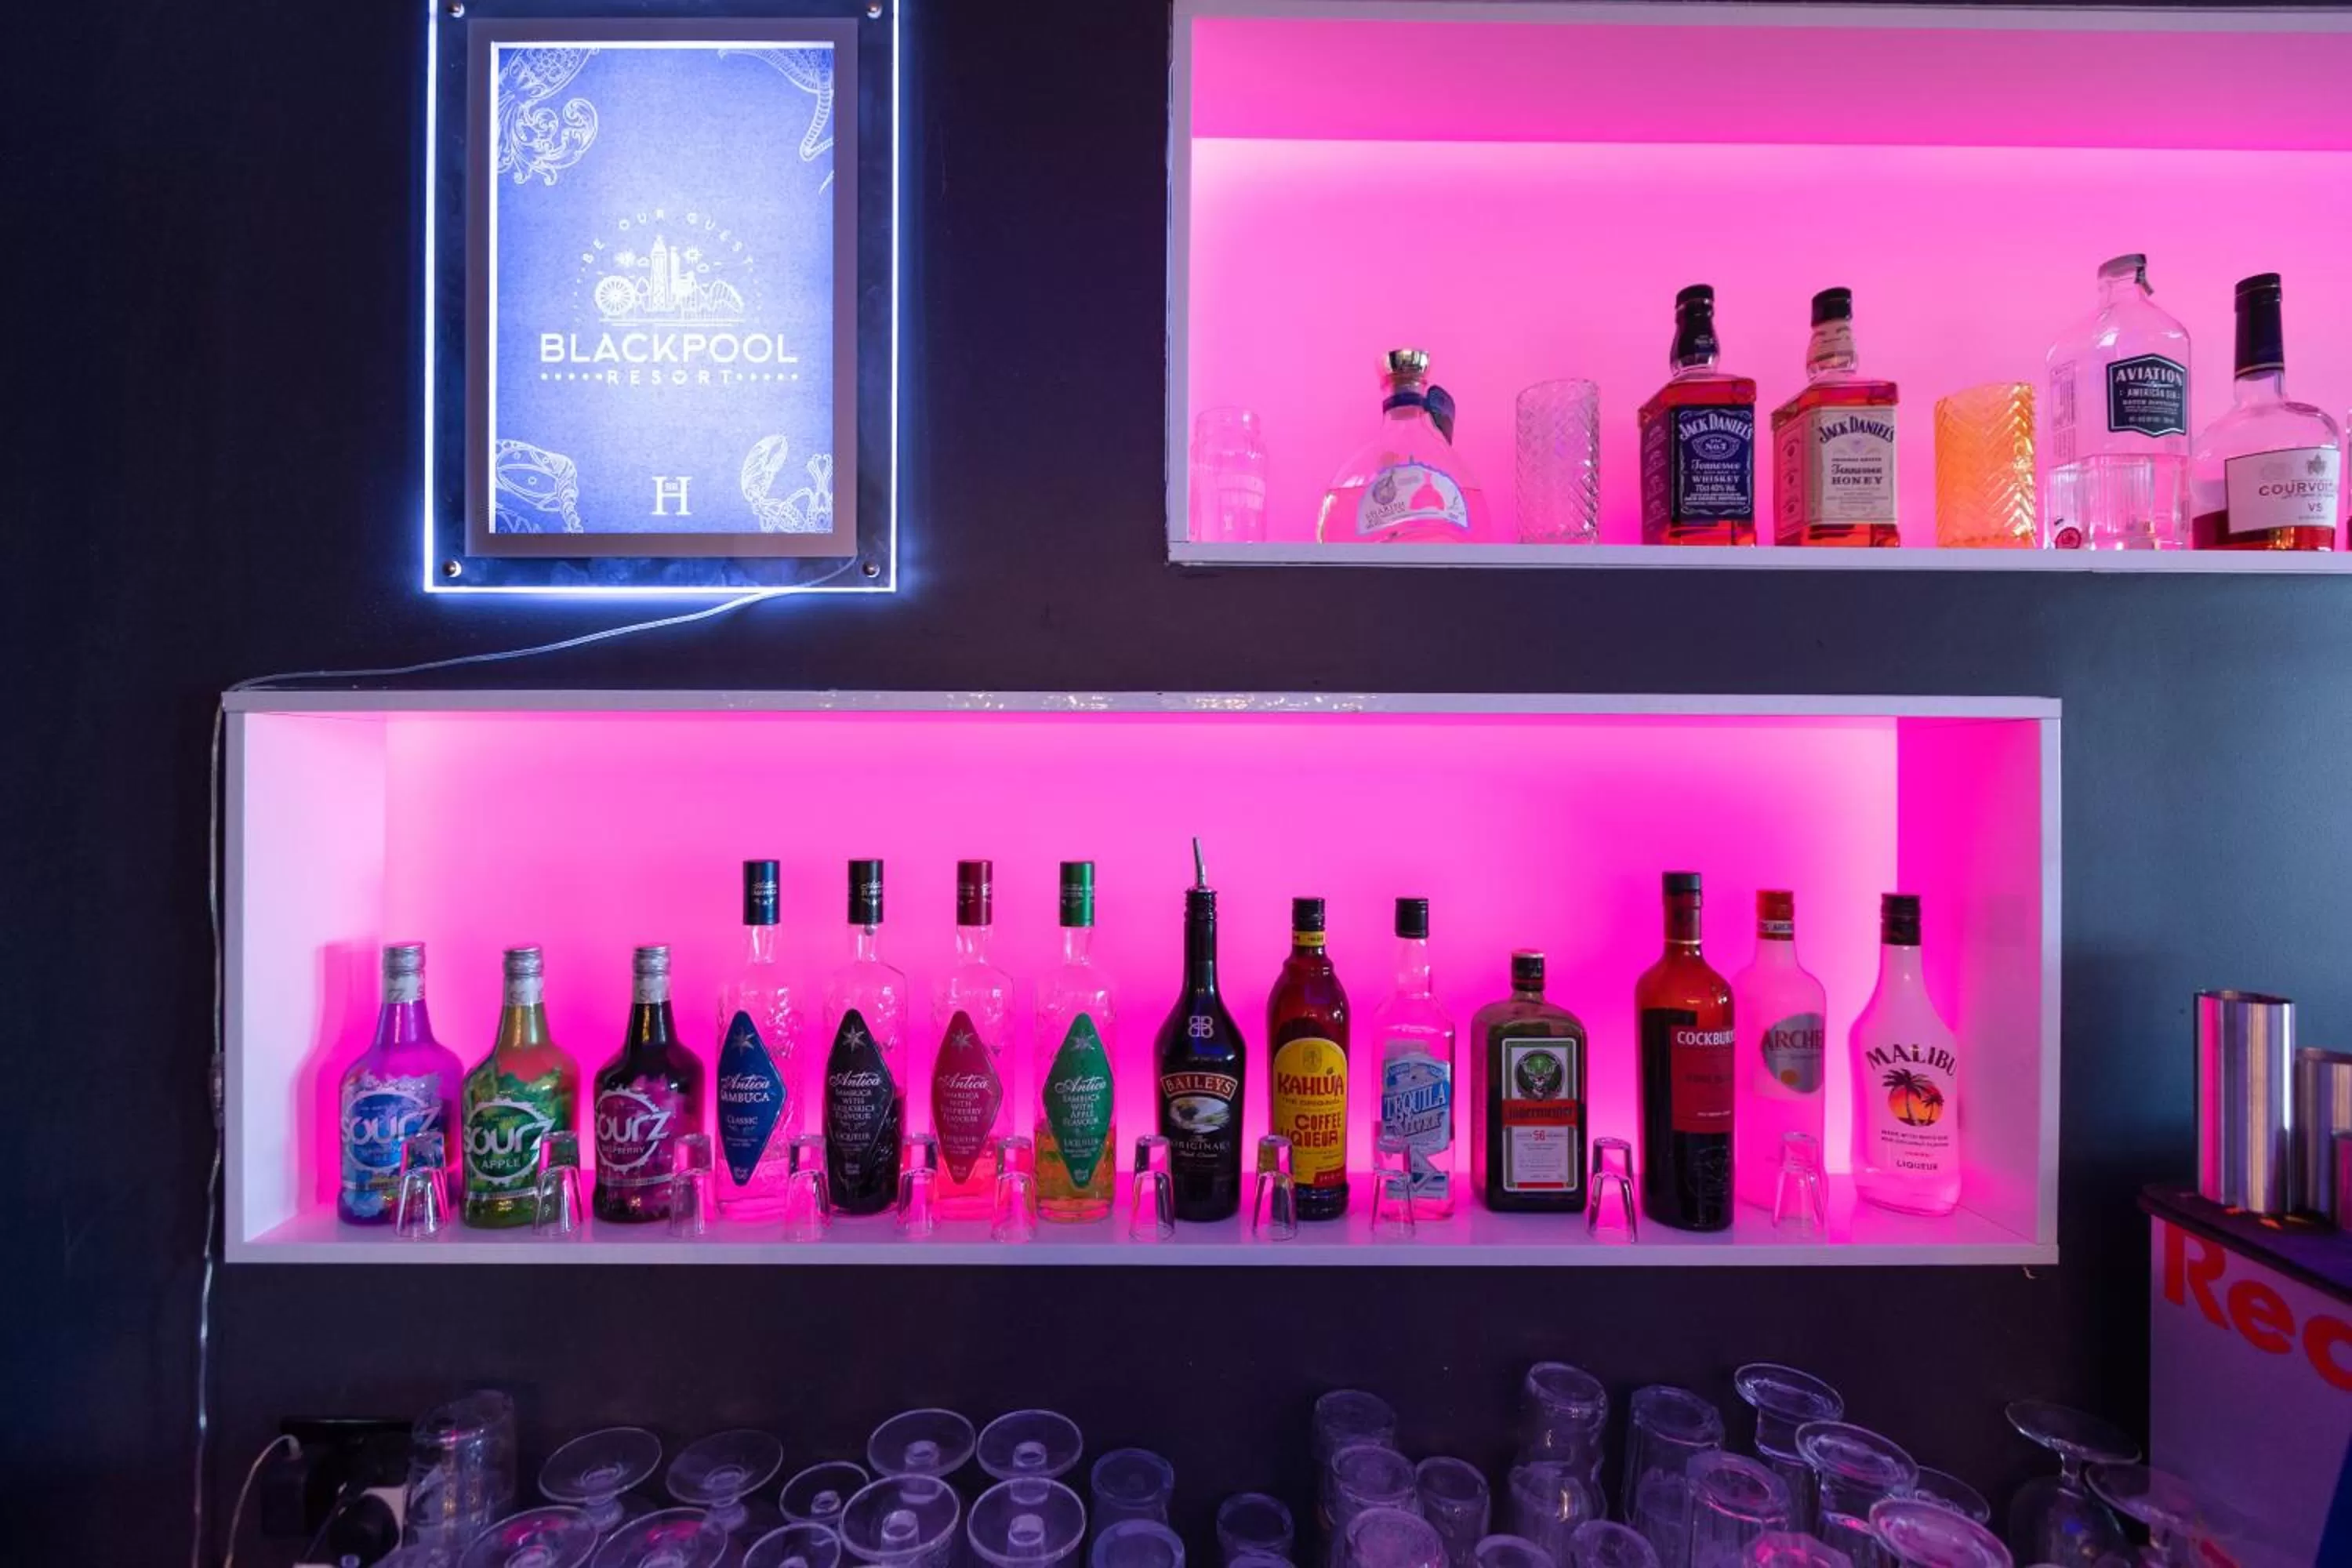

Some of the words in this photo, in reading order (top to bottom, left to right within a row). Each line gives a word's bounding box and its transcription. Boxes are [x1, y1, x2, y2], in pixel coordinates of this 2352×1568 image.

[619, 208, 665, 230] OUR
[685, 212, 754, 263] GUEST
[539, 332, 798, 364] BLACKPOOL
[607, 369, 734, 386] RESORT
[1679, 417, 1708, 441] JACK
[1819, 420, 1849, 444] JACK
[1831, 476, 1882, 485] HONEY
[652, 476, 693, 515] H
[2307, 503, 2323, 512] VS
[1865, 1044, 1958, 1076] MALIBU
[829, 1069, 881, 1087] Antica
[1166, 1075, 1232, 1094] BAILEYS
[1384, 1082, 1446, 1120] TEQUILA
[1294, 1112, 1341, 1131] COFFEE
[481, 1156, 521, 1170] APPLE
[1896, 1160, 1938, 1171] LIQUEUR
